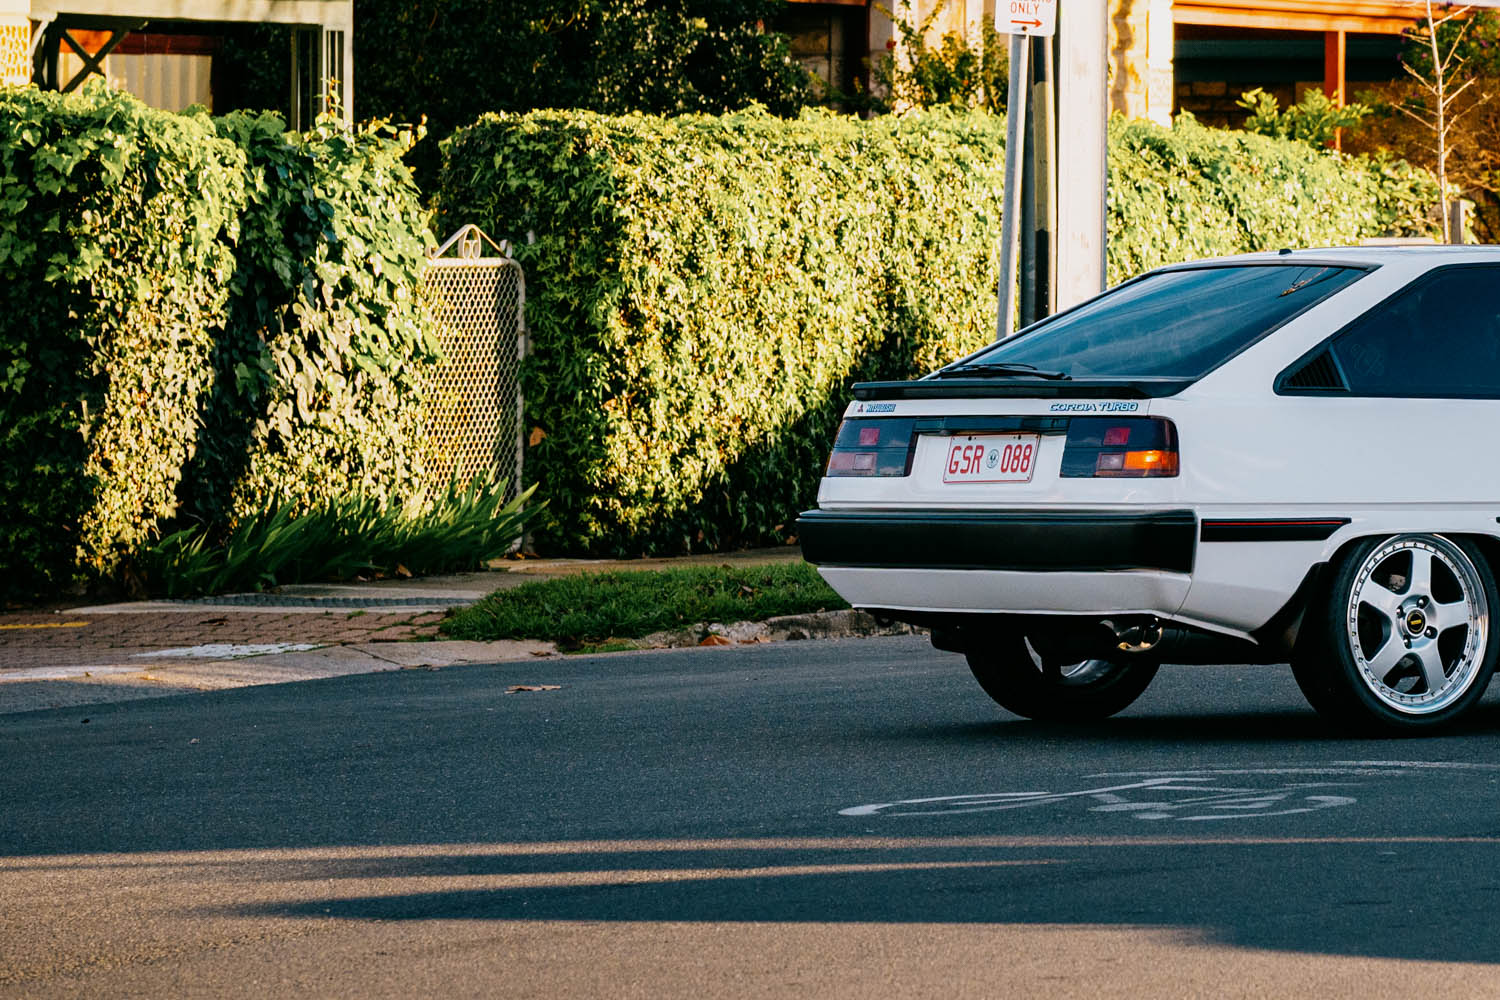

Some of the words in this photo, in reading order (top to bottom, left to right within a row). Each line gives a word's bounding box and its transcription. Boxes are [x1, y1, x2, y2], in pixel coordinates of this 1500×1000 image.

[1010, 1, 1040, 16] ONLY
[1049, 403, 1097, 412] CORDIA
[1099, 402, 1139, 412] TURBO
[948, 445, 985, 475] GSR
[1000, 443, 1033, 473] 088
